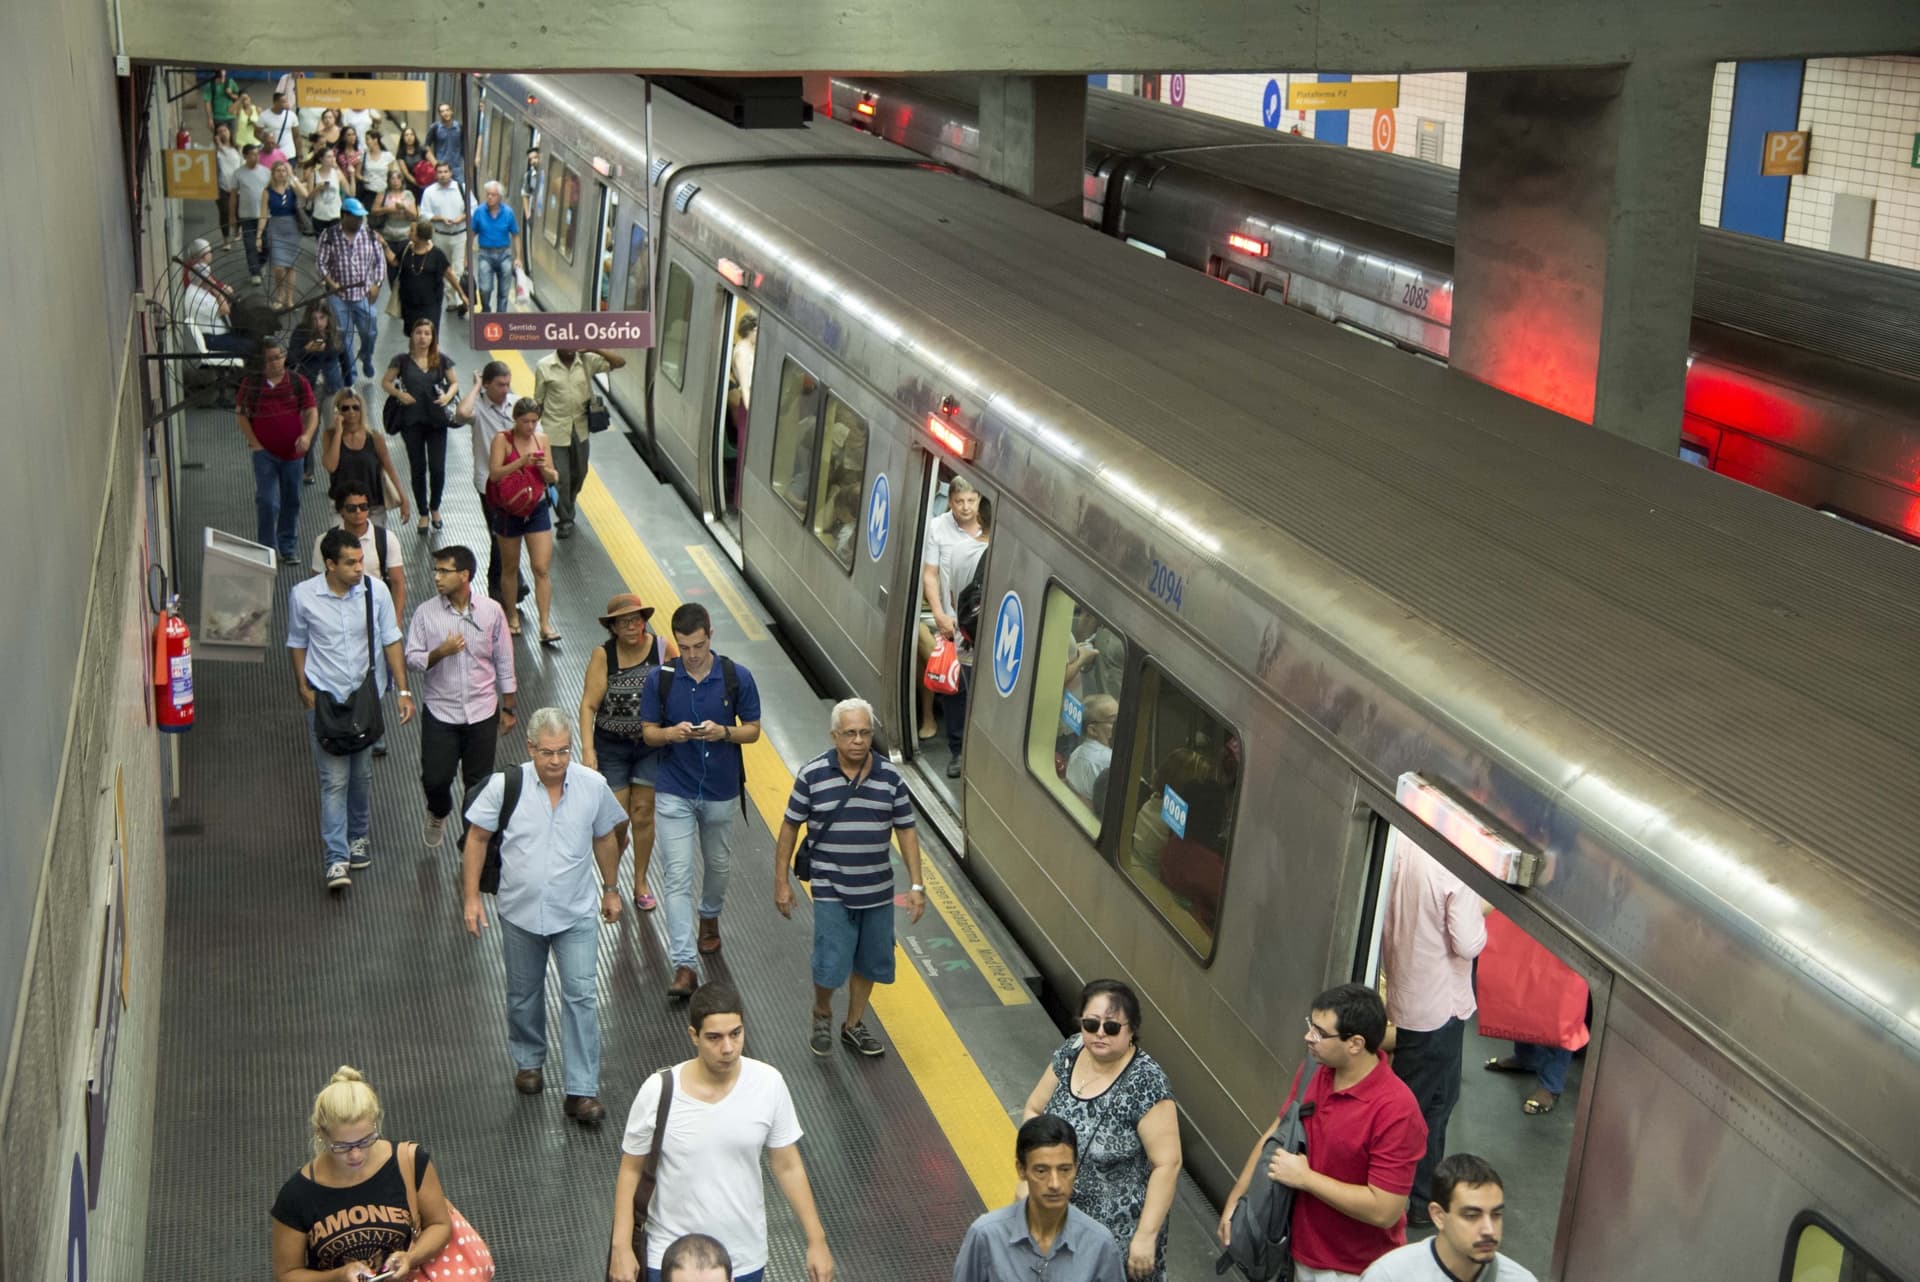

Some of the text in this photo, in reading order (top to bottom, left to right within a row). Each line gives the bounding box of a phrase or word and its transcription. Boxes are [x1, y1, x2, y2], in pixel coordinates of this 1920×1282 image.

[305, 86, 352, 96] Plataforma
[1769, 134, 1805, 162] P2
[173, 153, 210, 183] P1
[1403, 283, 1429, 310] 2085
[486, 327, 499, 338] L1
[508, 323, 537, 331] Sentido
[544, 321, 641, 341] Gal. Osório
[508, 333, 540, 342] Direction
[1148, 560, 1182, 613] 2094
